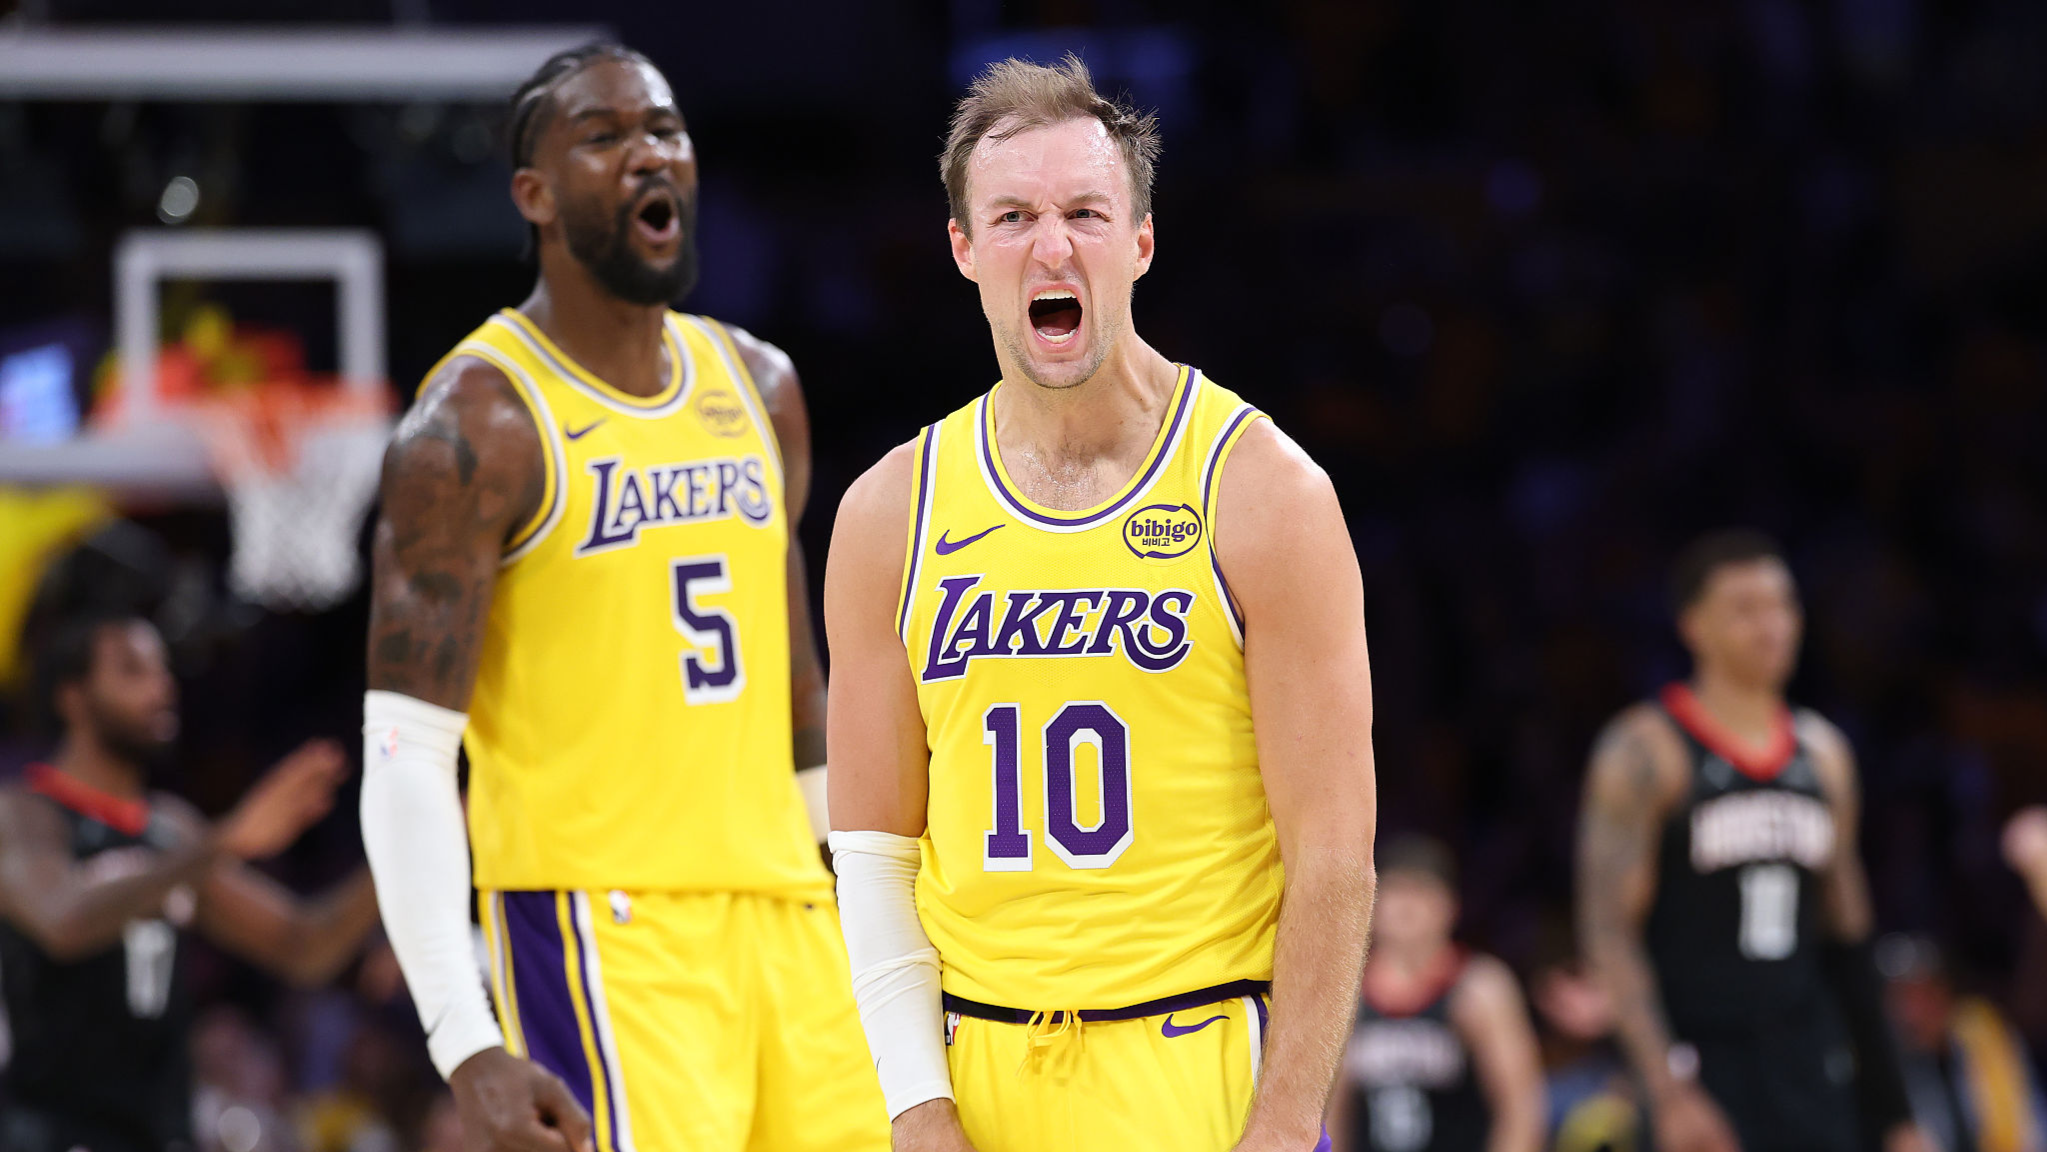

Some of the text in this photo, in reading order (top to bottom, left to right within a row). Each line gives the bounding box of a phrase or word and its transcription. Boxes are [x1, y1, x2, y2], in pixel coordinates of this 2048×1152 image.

[575, 456, 770, 557] LAKERS
[1131, 519, 1198, 542] bibigo
[1142, 538, 1170, 547] 비비고
[671, 555, 746, 704] 5
[922, 574, 1197, 684] LAKERS
[983, 701, 1134, 871] 10
